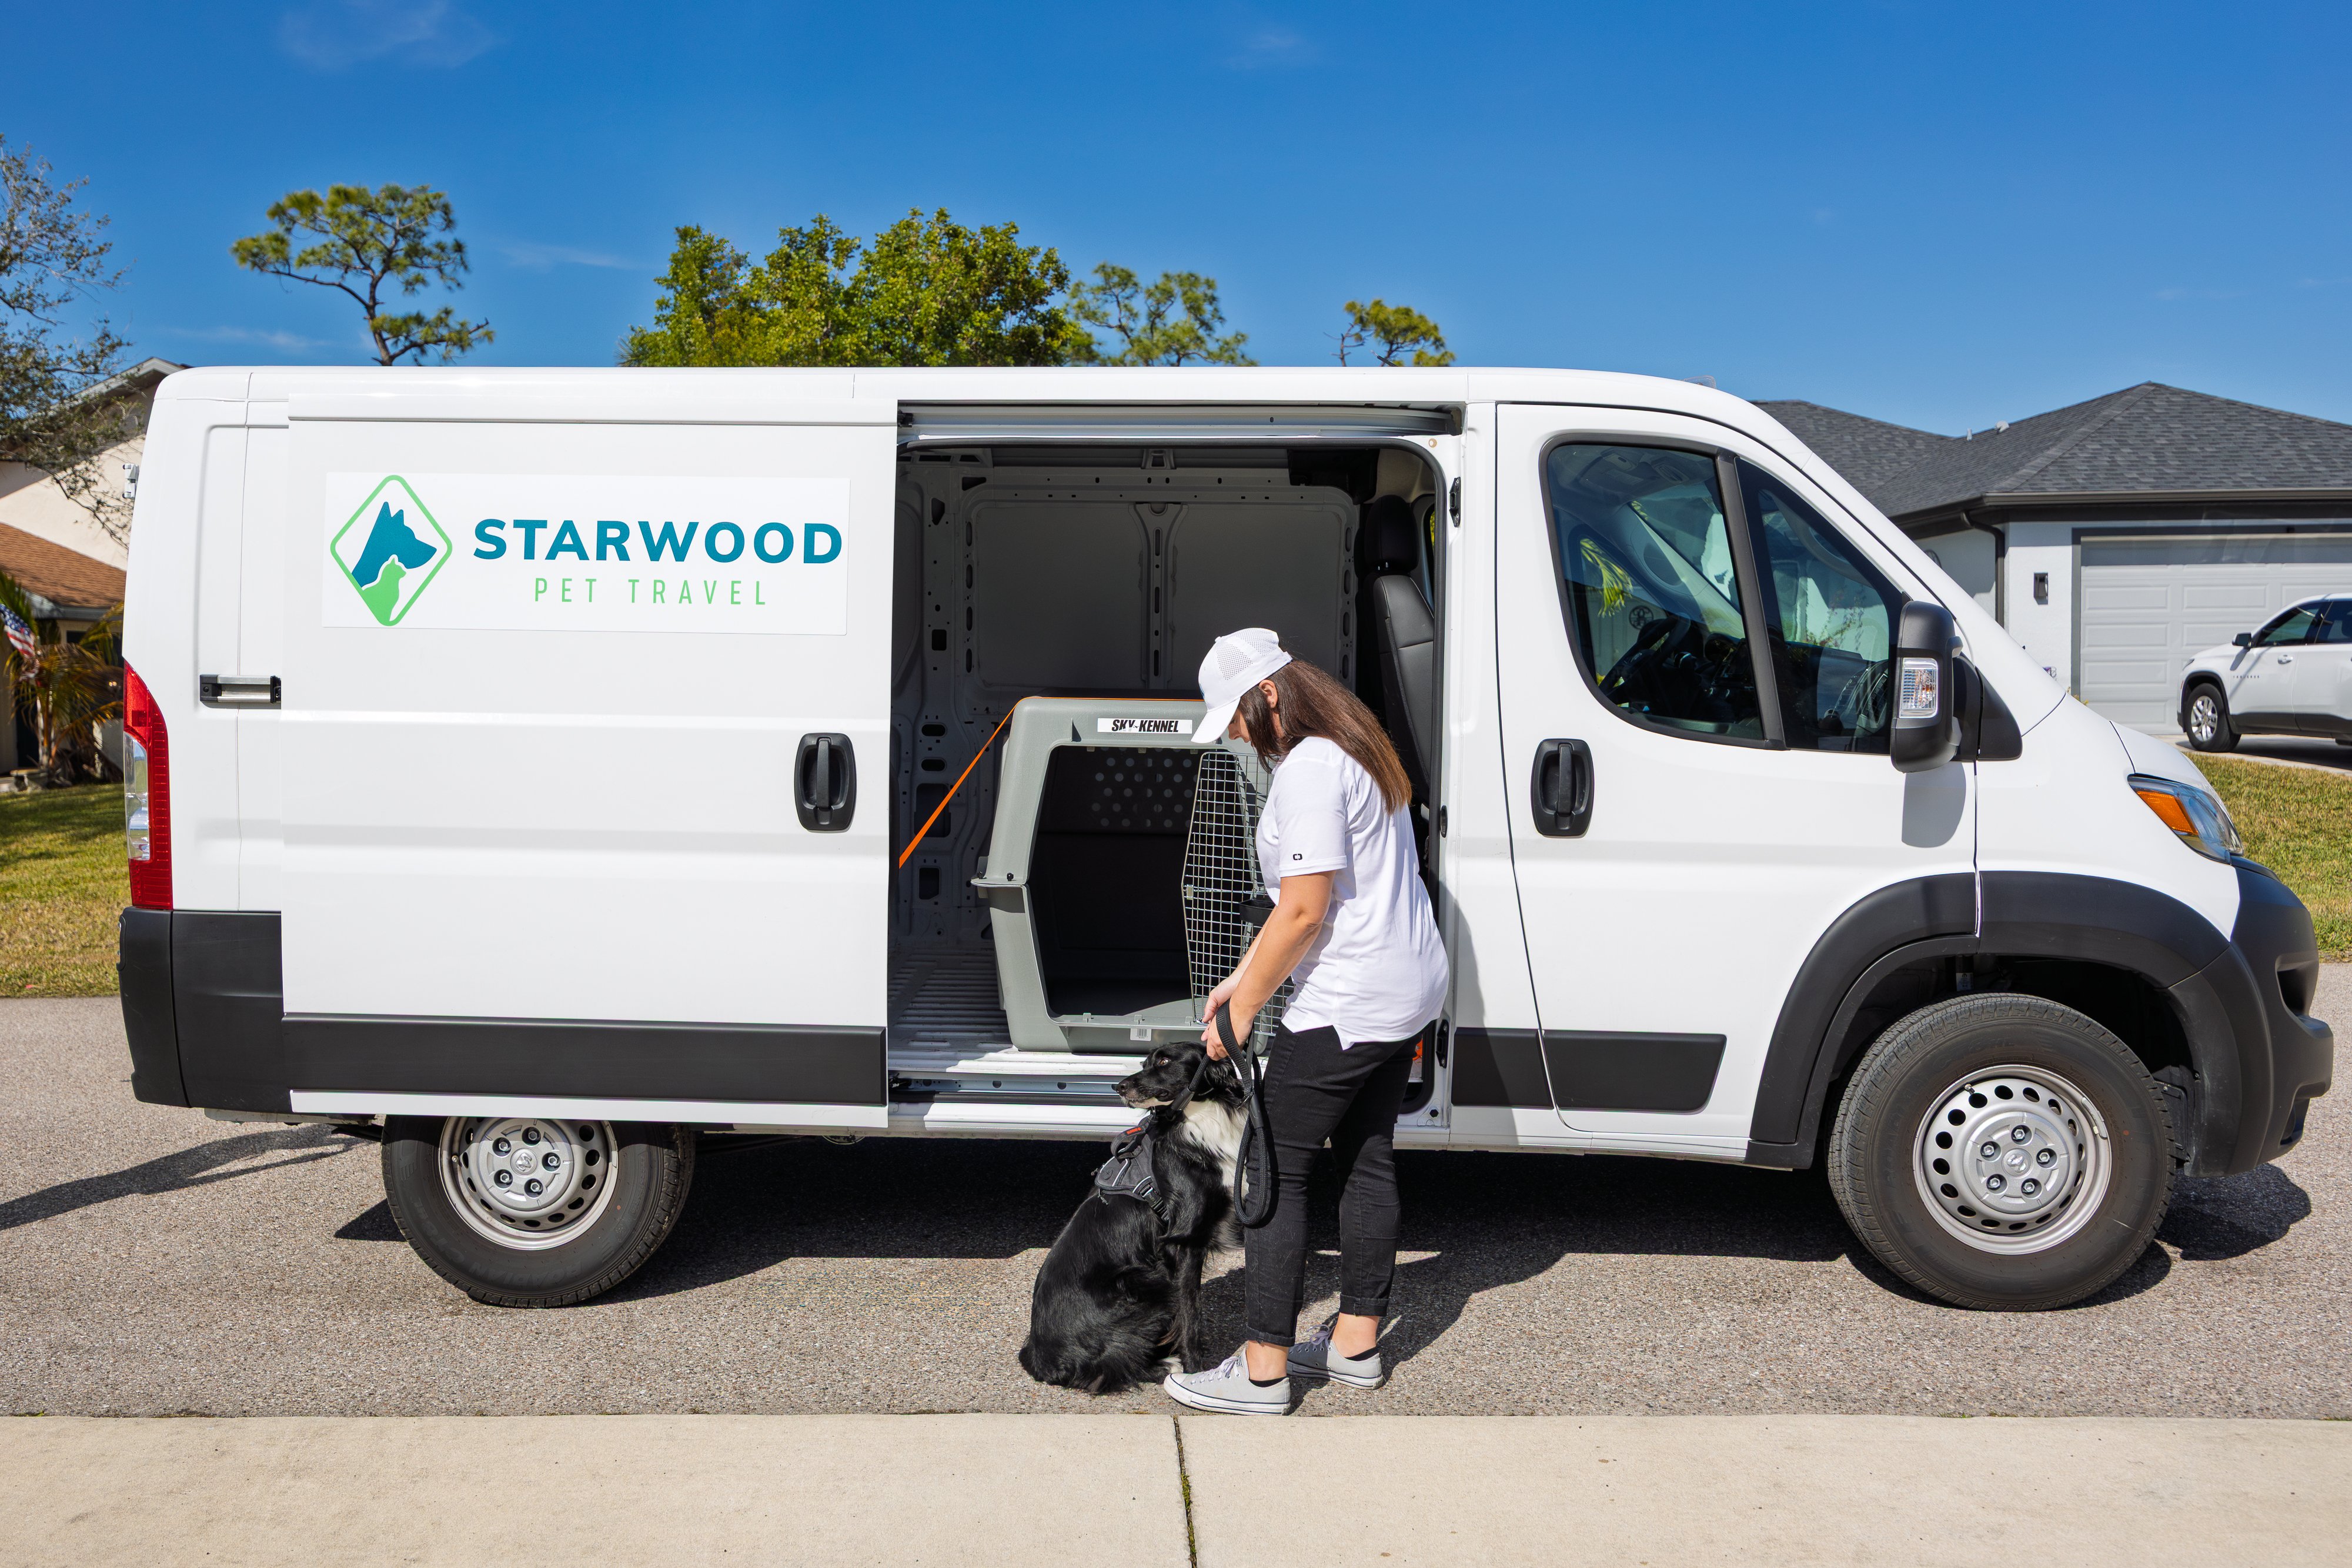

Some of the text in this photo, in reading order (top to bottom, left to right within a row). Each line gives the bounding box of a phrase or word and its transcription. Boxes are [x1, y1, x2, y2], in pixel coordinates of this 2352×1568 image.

[473, 519, 842, 564] STARWOOD
[535, 577, 766, 606] PET TRAVEL
